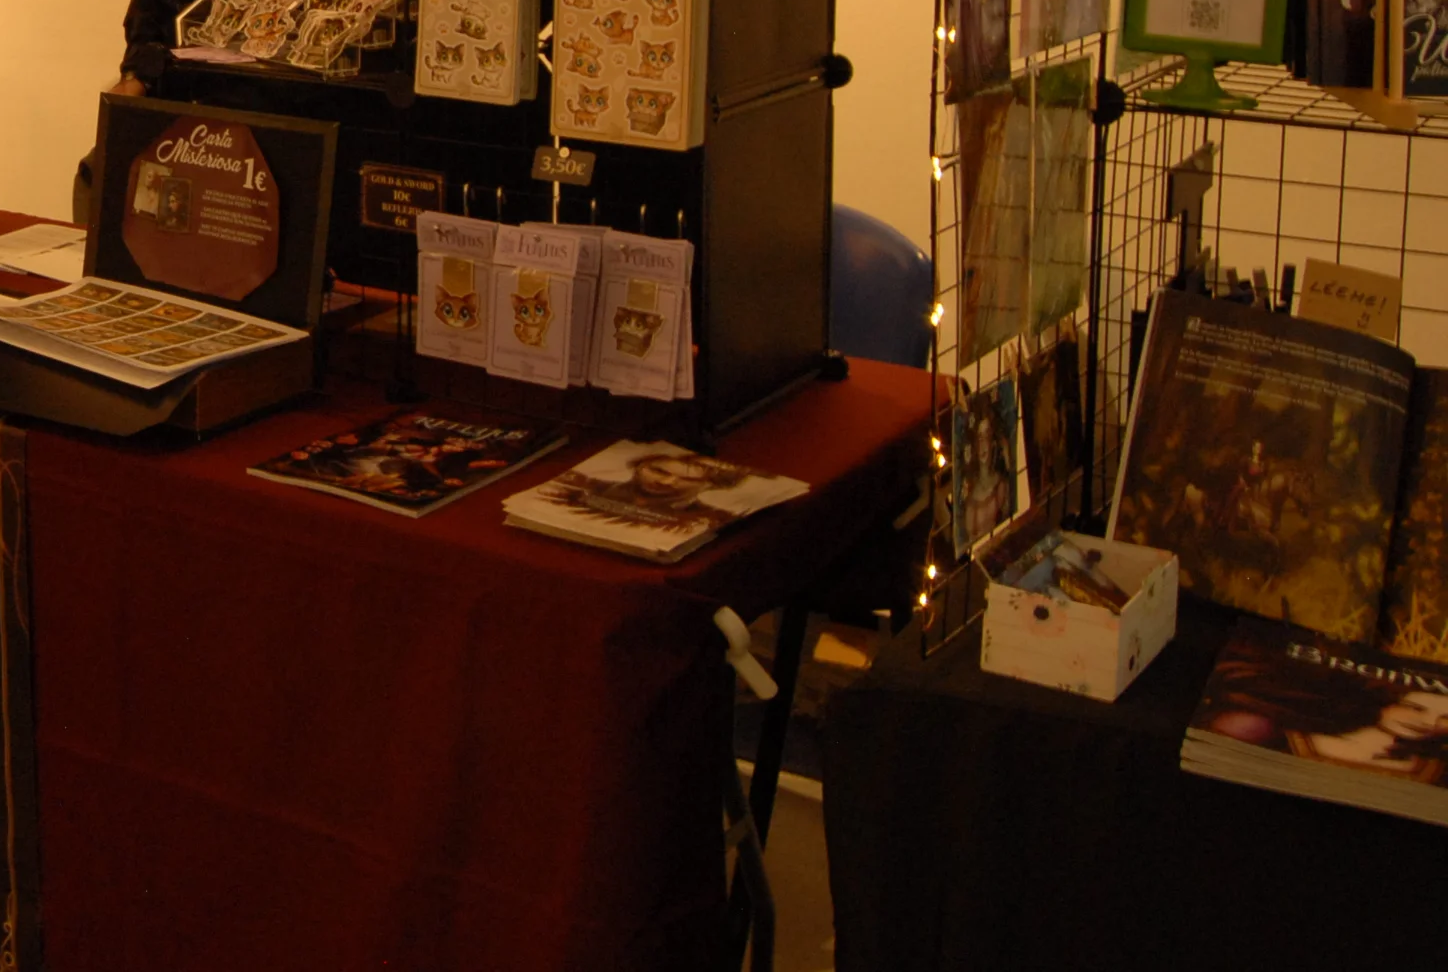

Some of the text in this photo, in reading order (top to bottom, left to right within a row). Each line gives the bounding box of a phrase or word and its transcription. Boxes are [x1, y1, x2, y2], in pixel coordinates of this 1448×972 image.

[189, 123, 234, 149] Carta
[156, 138, 268, 192] Misteriosa 1€
[539, 155, 587, 177] 3,50€
[371, 174, 394, 187] GOLD
[393, 189, 413, 202] 10€
[394, 215, 410, 229] 6€
